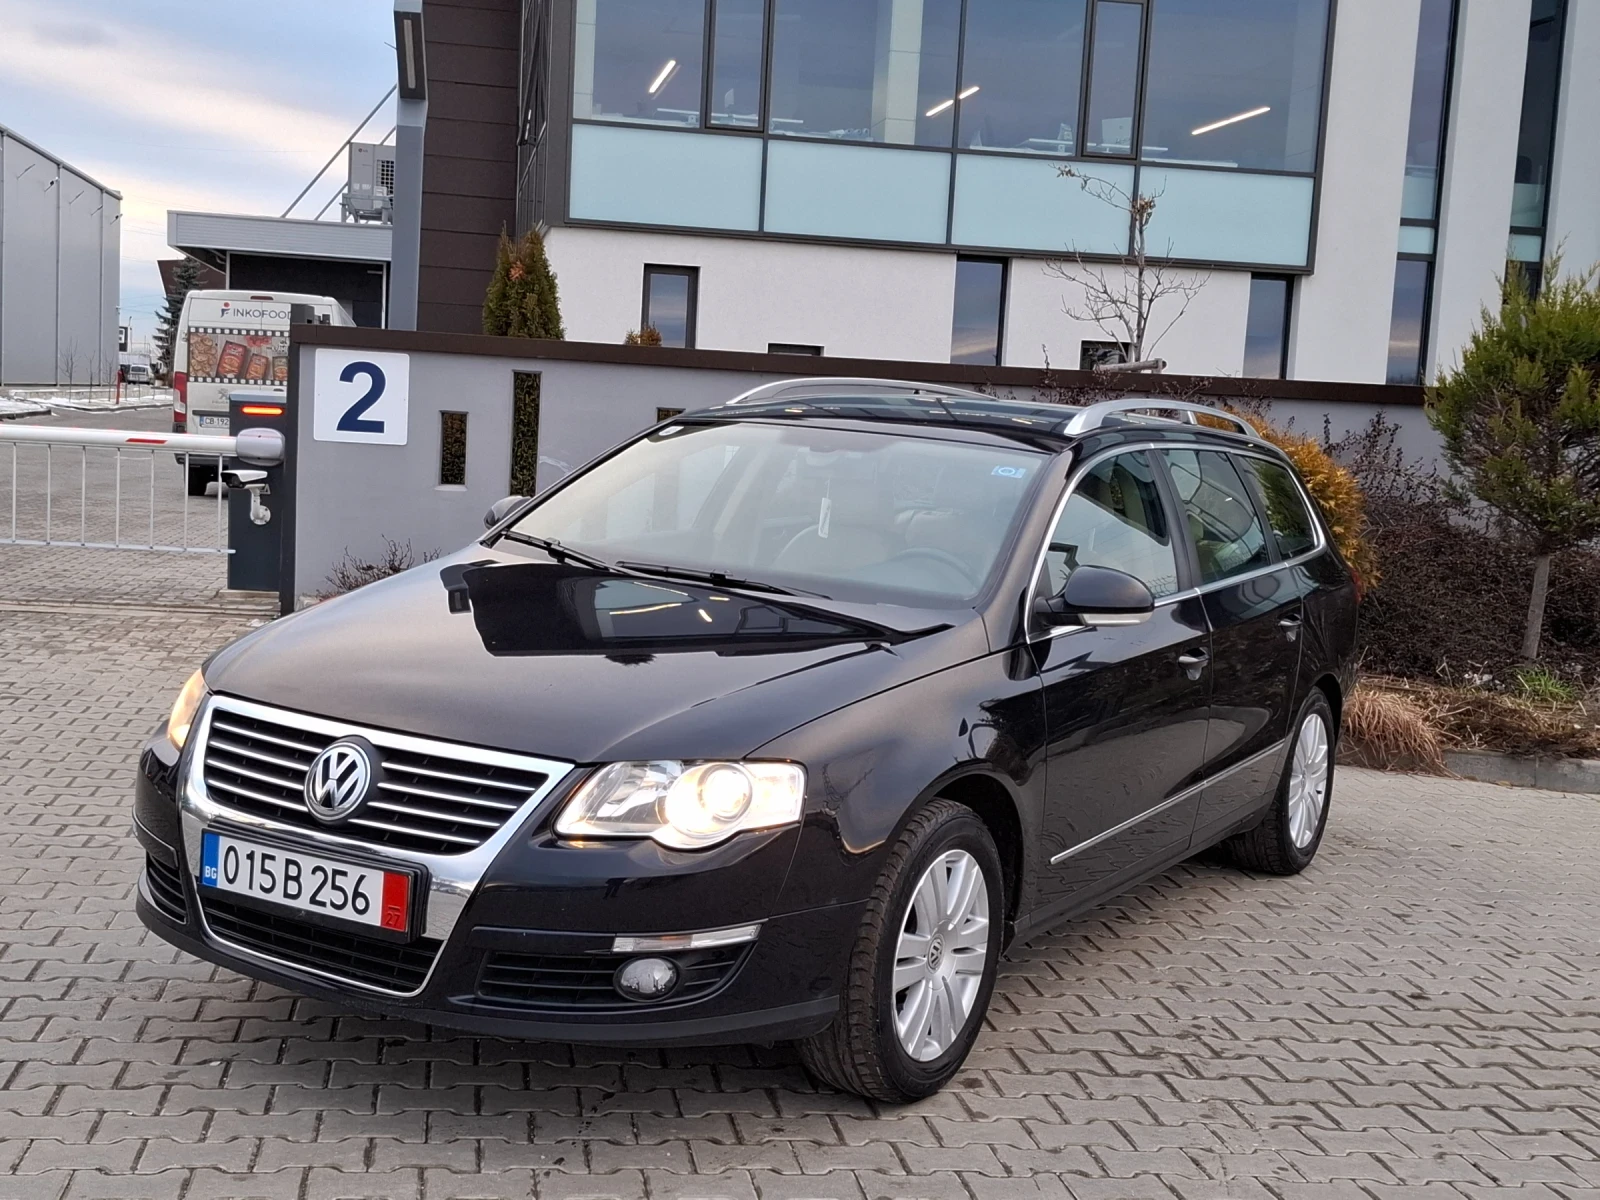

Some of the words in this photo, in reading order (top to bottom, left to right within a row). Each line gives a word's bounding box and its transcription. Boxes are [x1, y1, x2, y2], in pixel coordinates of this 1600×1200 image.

[336, 361, 386, 434] 2
[205, 865, 217, 879] BG
[223, 845, 370, 916] 015B256
[386, 911, 401, 927] 27
